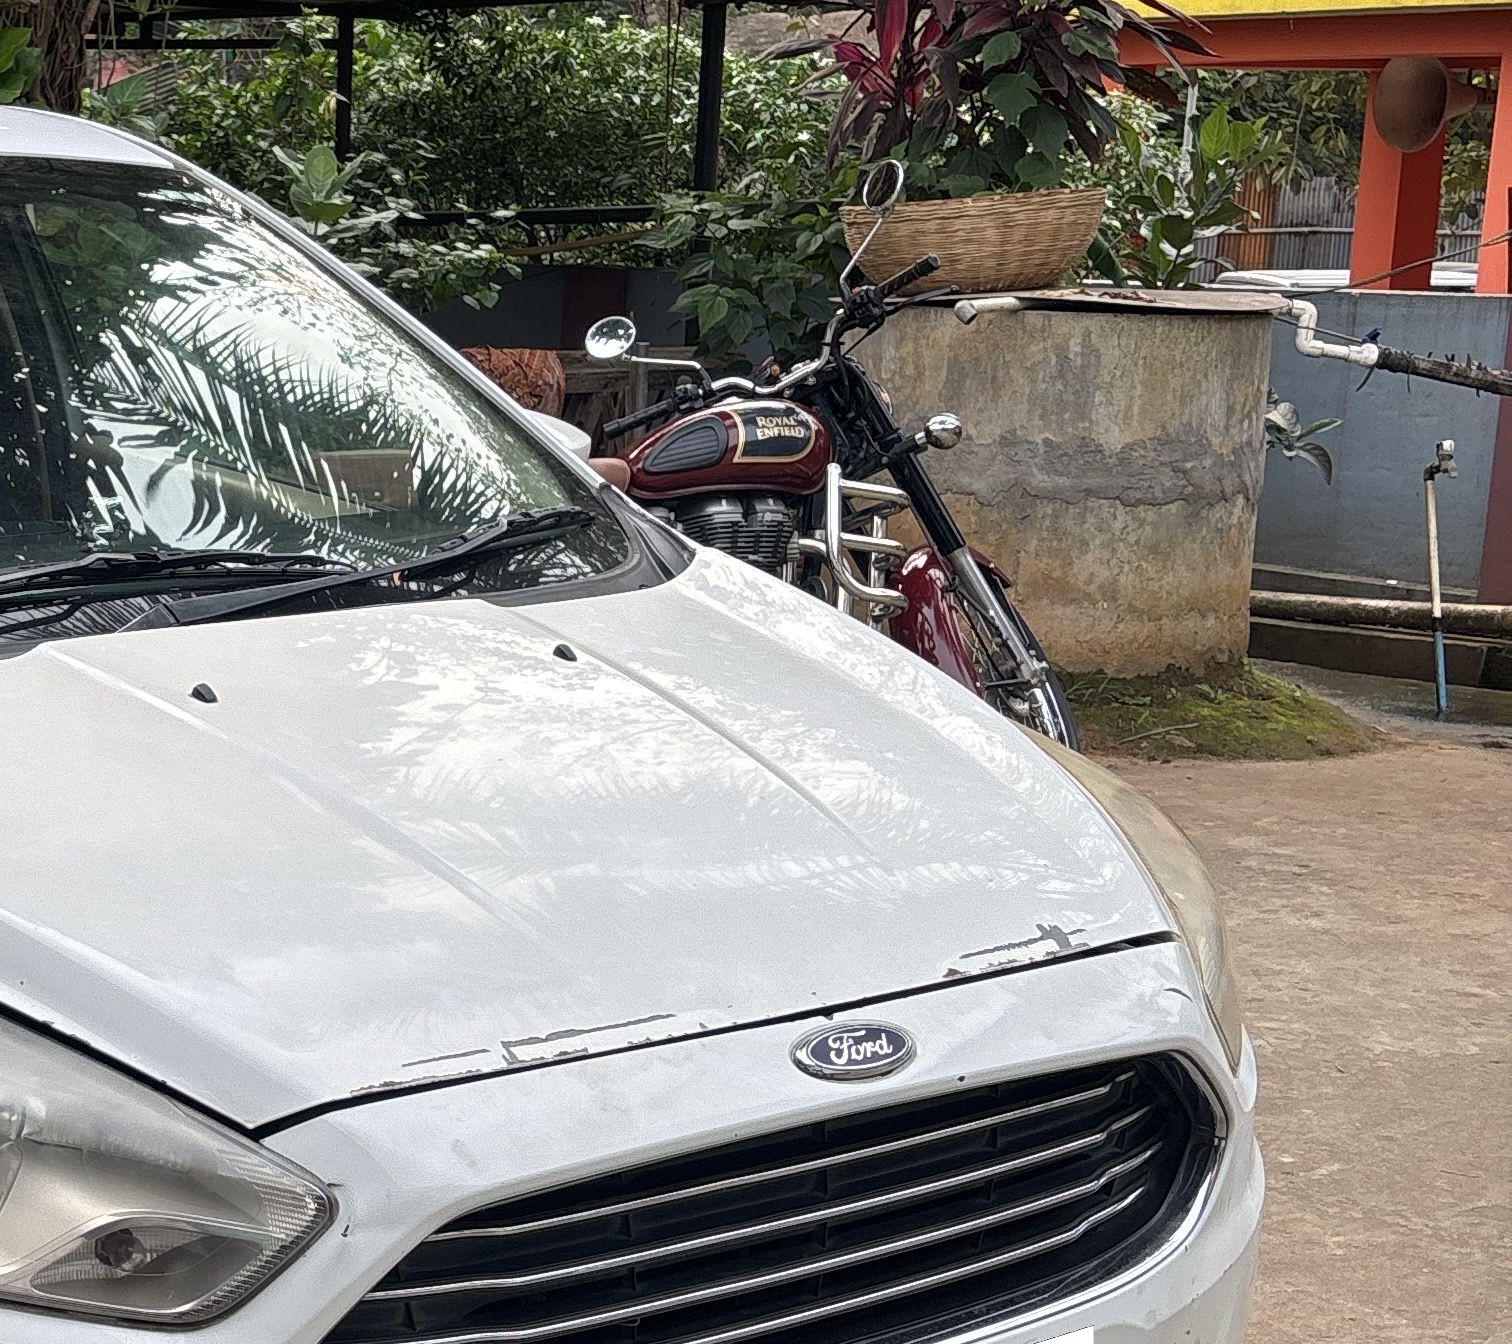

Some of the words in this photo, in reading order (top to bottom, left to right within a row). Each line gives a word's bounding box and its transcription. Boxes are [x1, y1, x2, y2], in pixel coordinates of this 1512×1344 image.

[756, 416, 798, 428] ROYAL
[756, 426, 805, 440] ENFIELD
[828, 1030, 893, 1065] Ford
